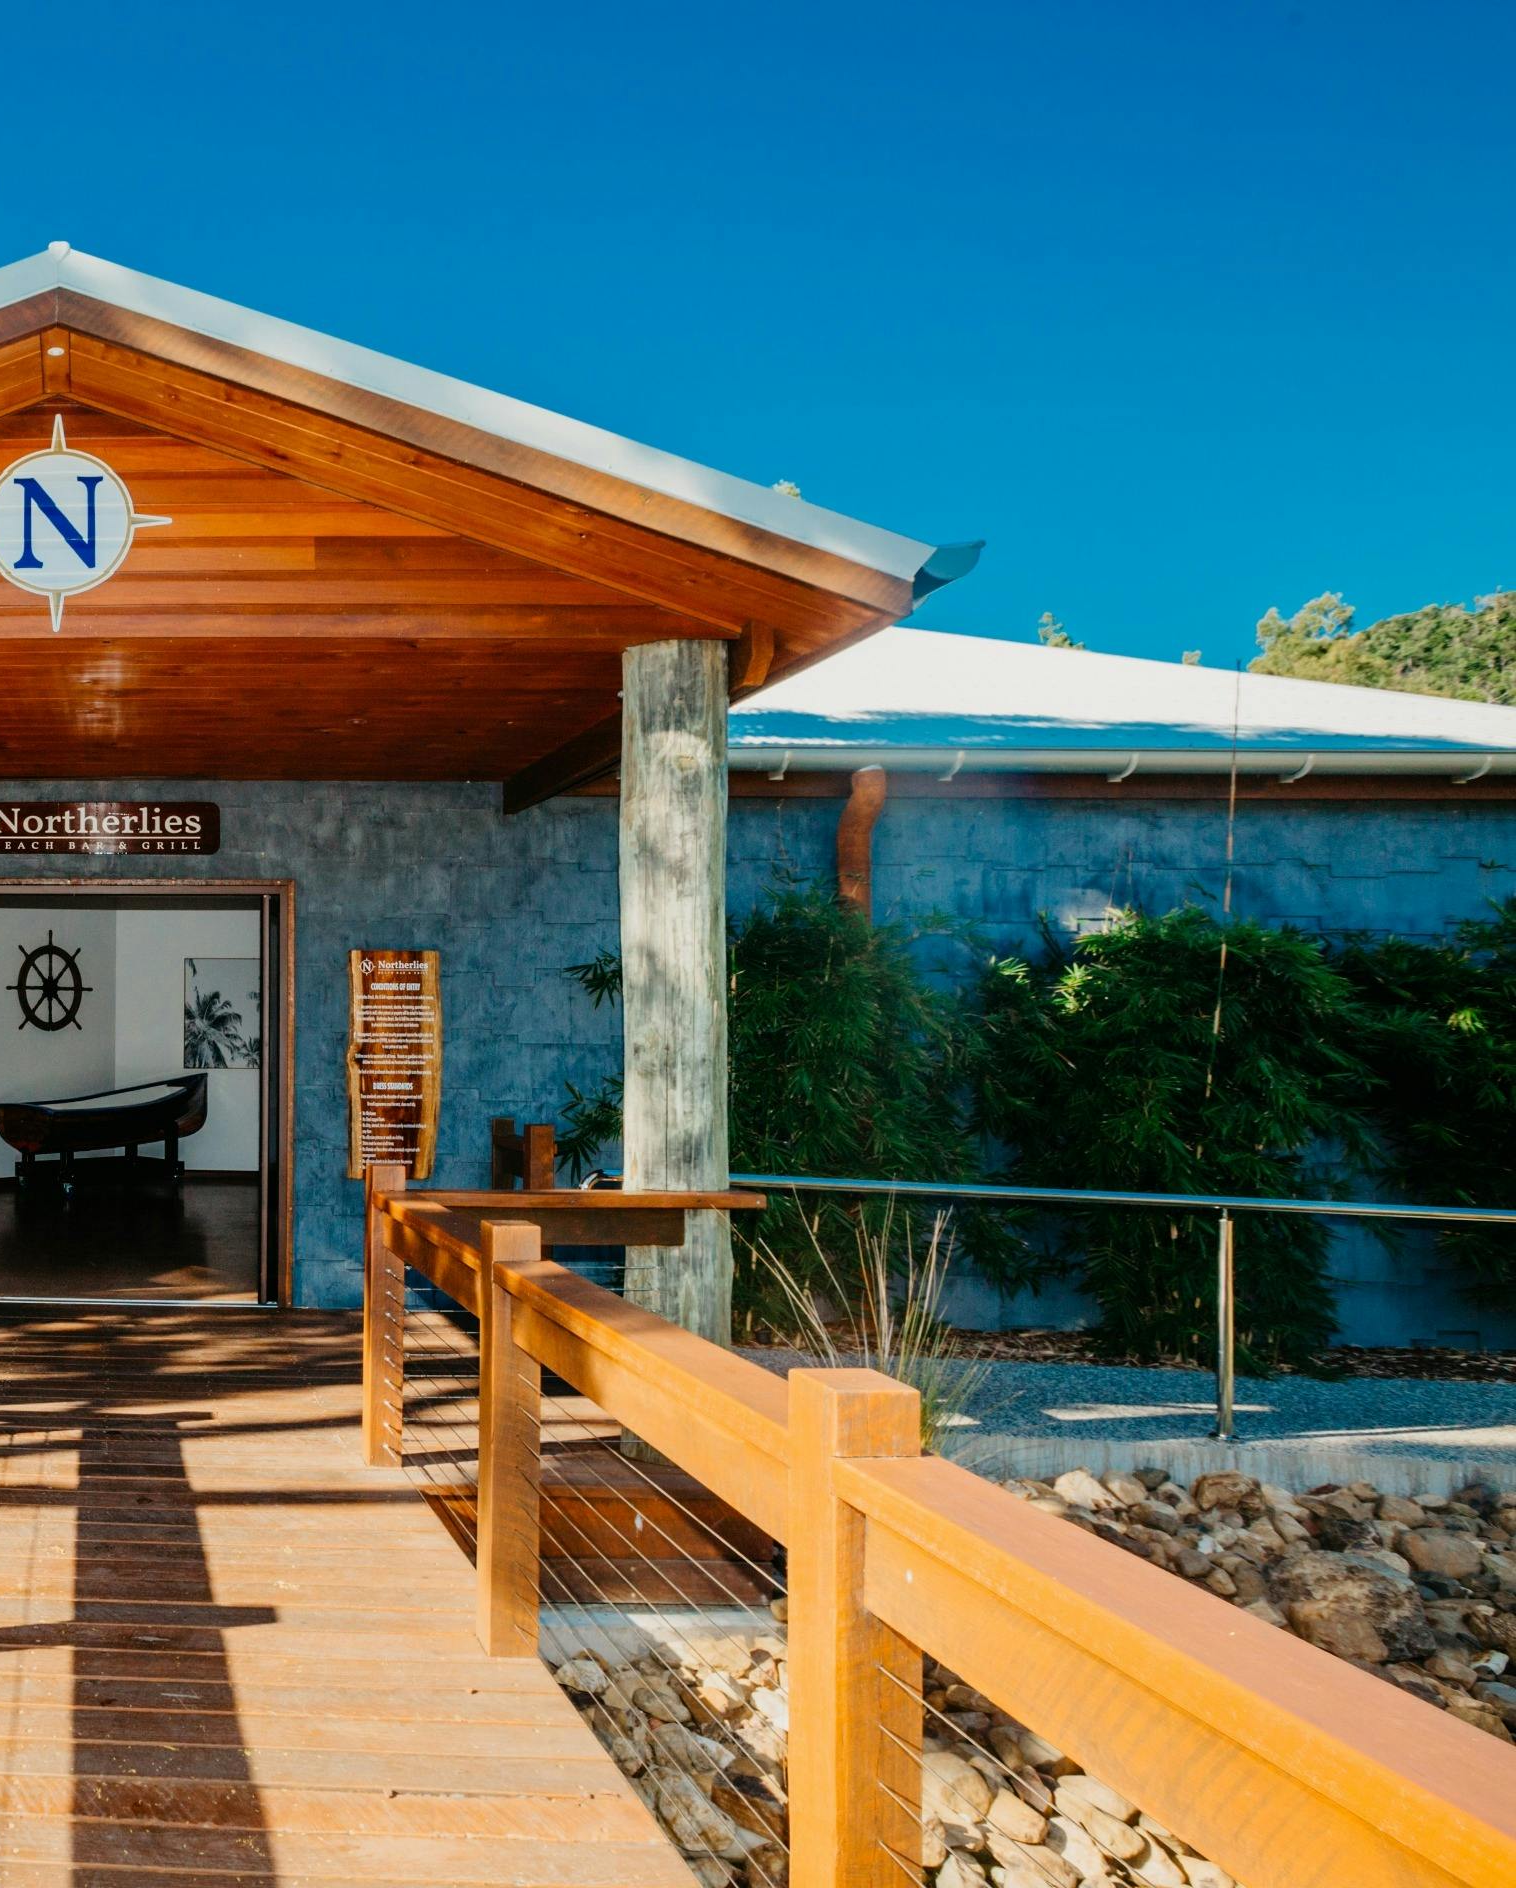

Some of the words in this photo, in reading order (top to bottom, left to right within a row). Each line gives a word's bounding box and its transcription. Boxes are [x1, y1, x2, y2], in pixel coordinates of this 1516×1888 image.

[14, 476, 104, 569] N
[68, 841, 105, 850] BAR
[118, 841, 127, 850] &
[141, 841, 201, 850] GRILL
[377, 960, 429, 969] Northerlies
